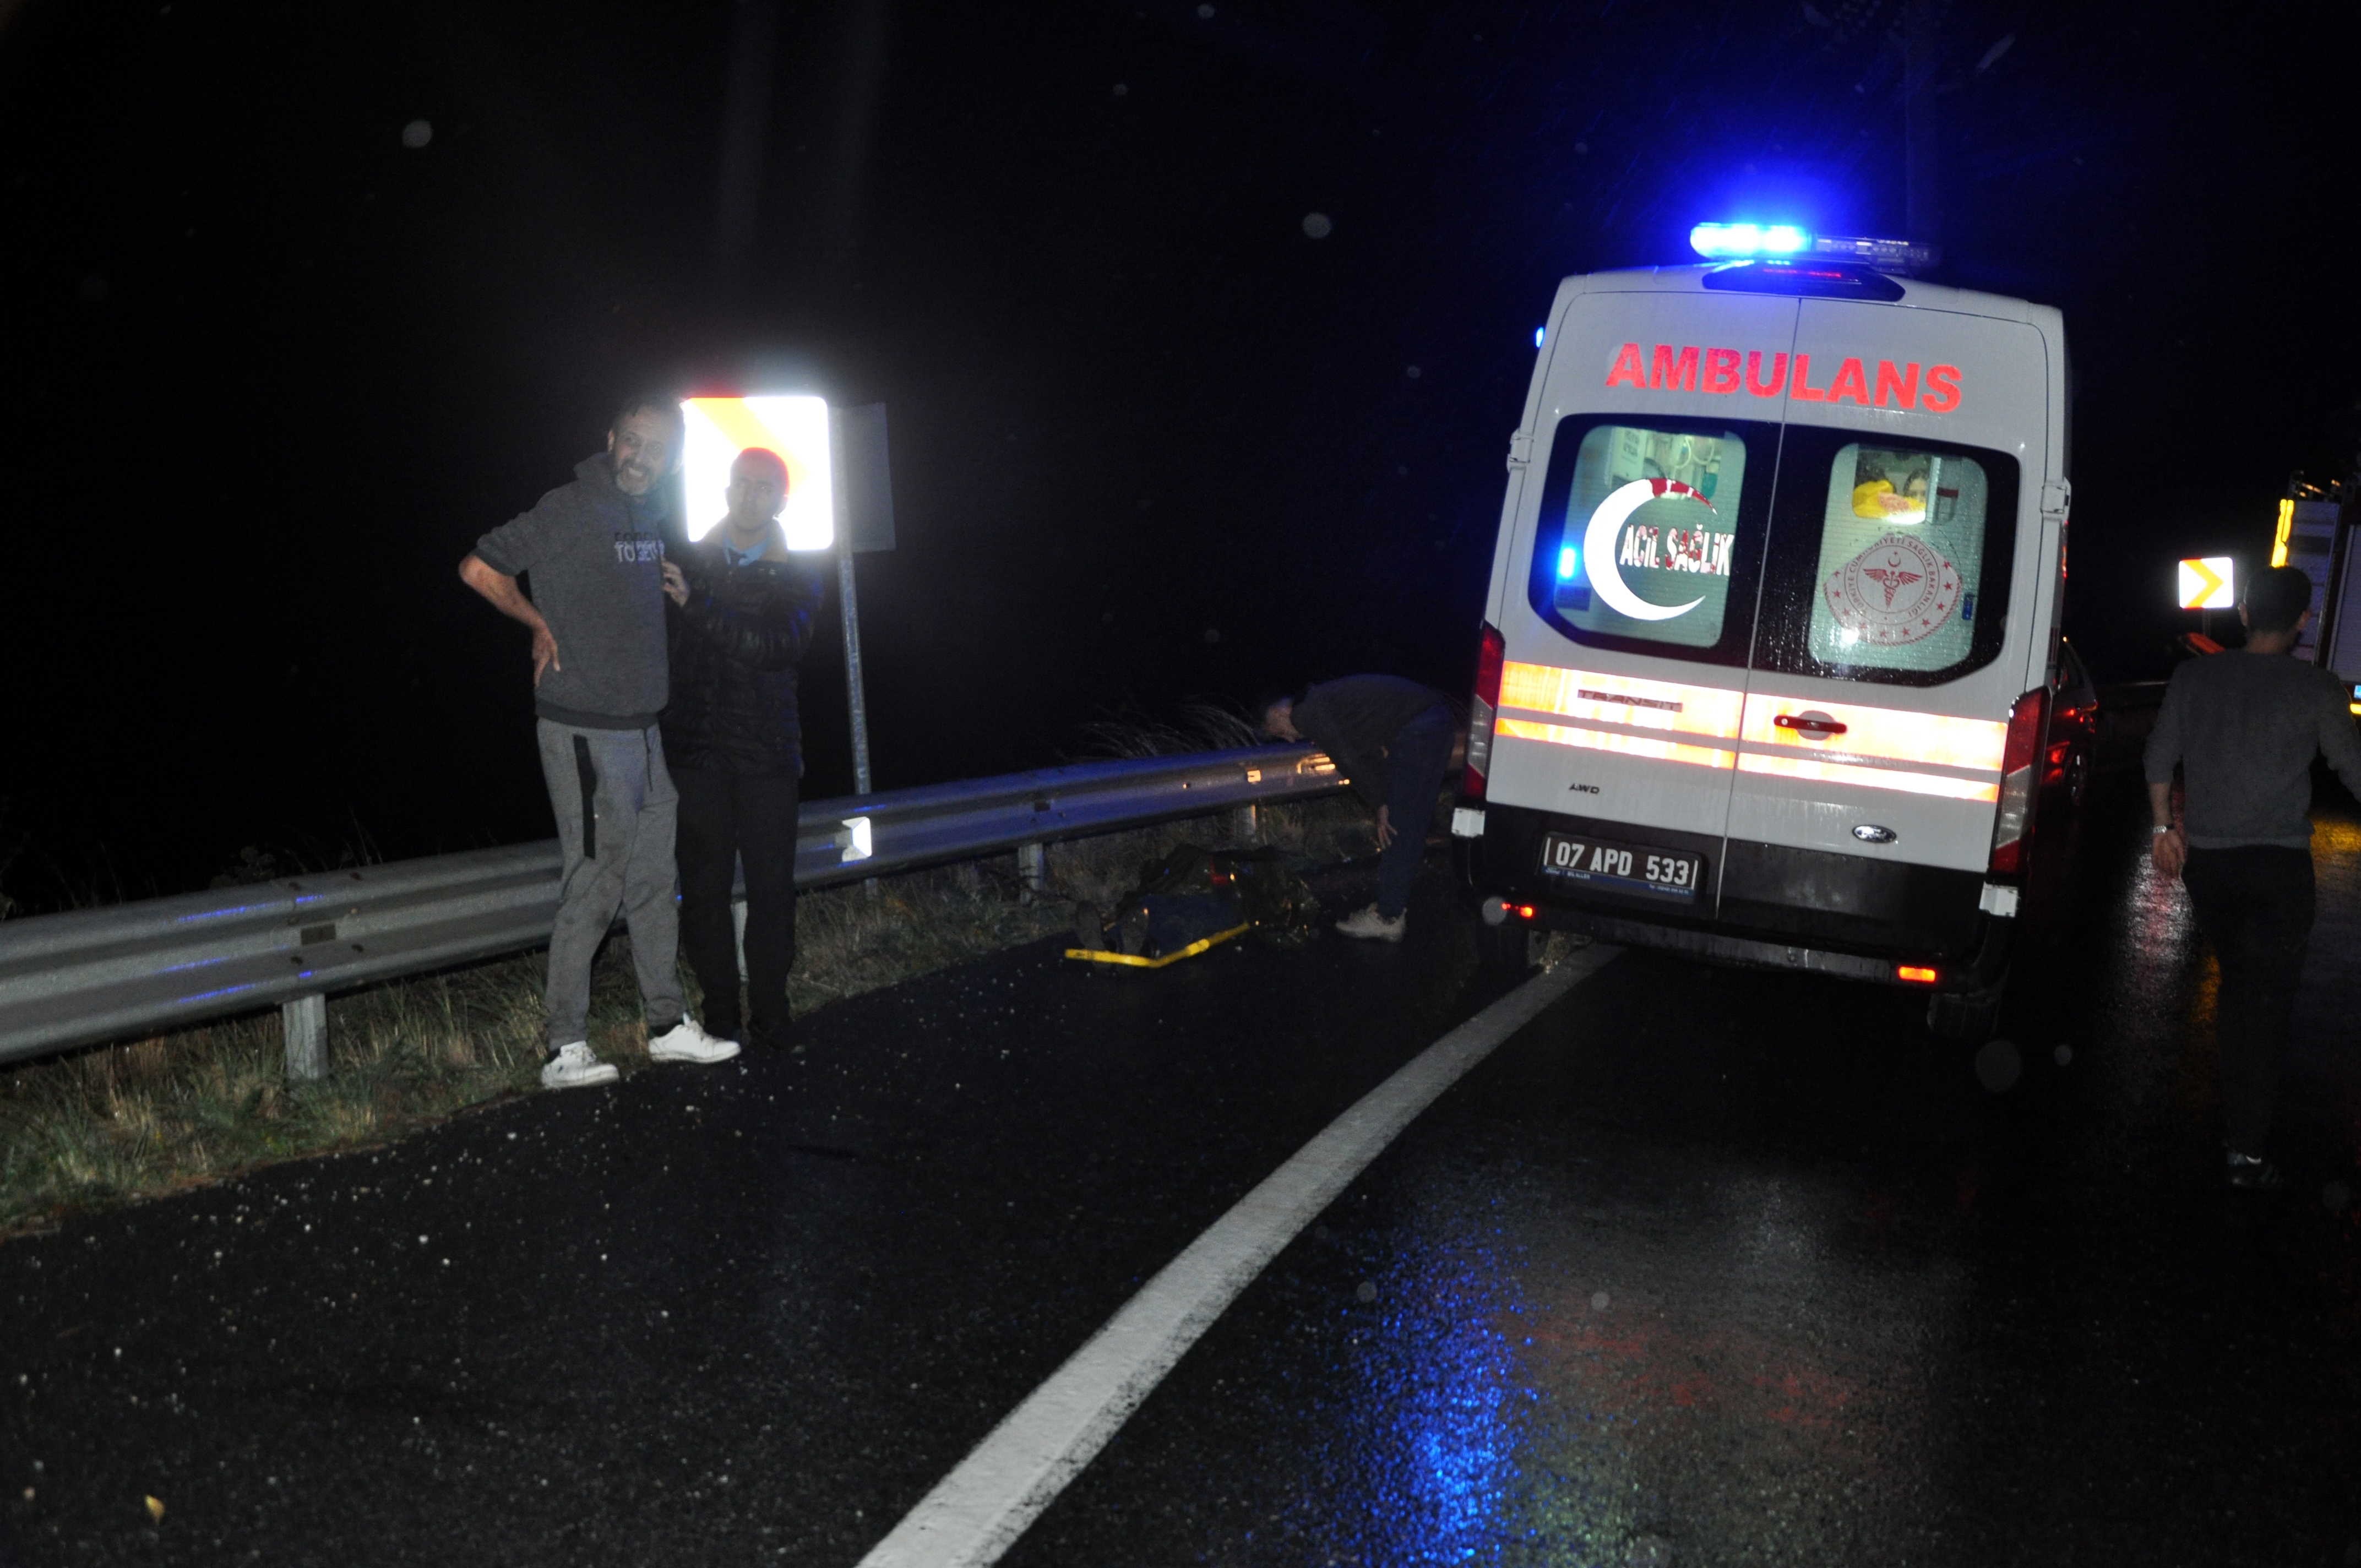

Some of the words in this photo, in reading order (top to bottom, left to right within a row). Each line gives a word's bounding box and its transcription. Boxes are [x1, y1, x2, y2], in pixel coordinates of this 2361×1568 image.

[1606, 342, 1962, 413] AMBULANS
[1569, 782, 1600, 794] AWD
[1555, 841, 1585, 868] 07
[1590, 847, 1633, 876] APD
[1646, 855, 1689, 885] 533
